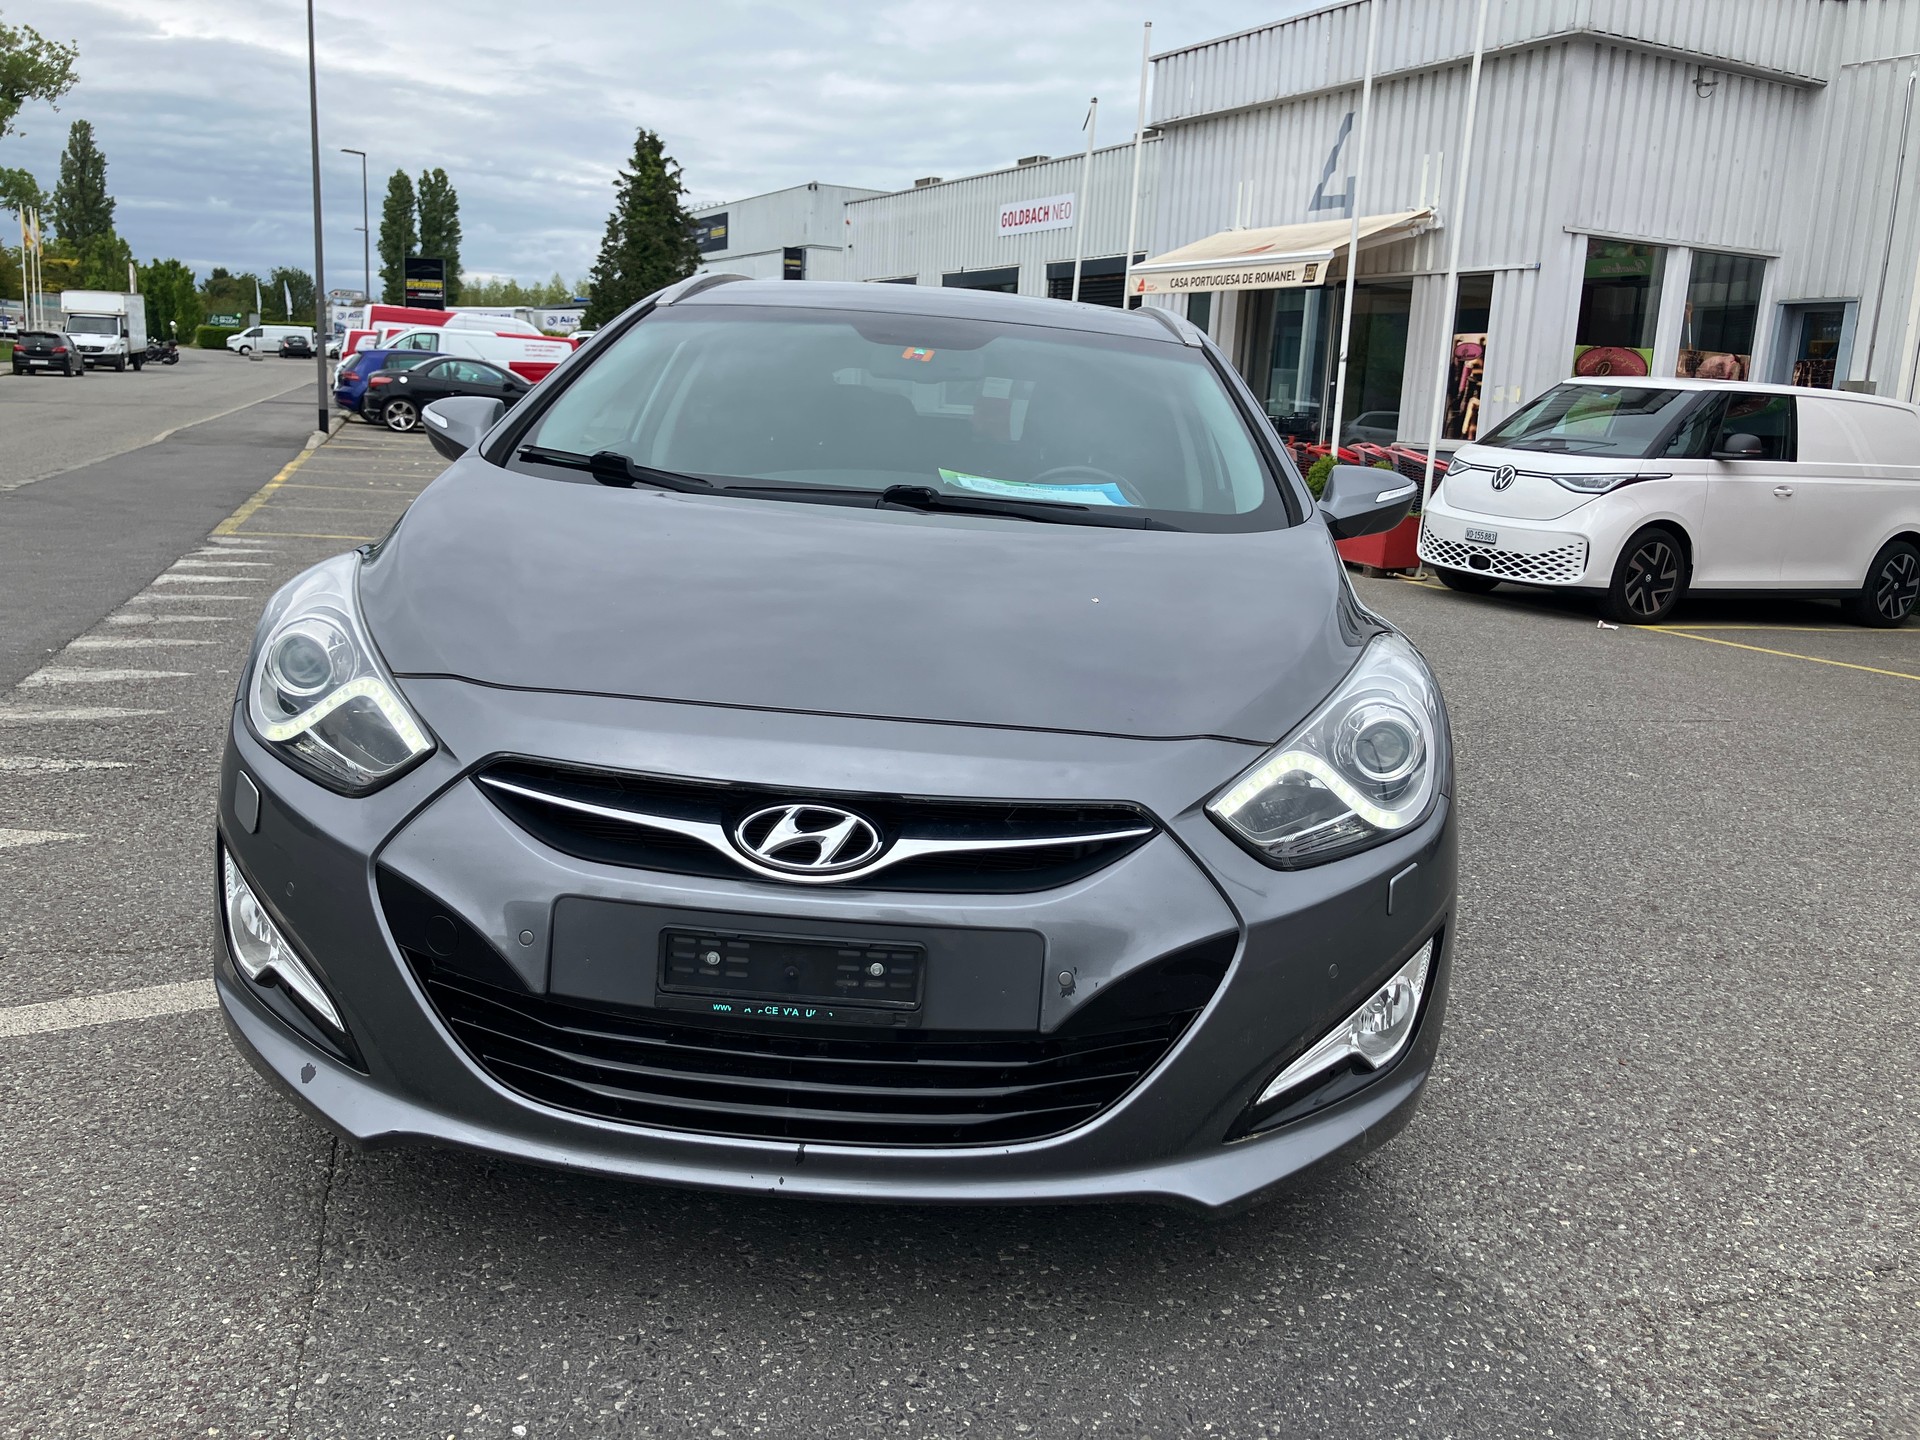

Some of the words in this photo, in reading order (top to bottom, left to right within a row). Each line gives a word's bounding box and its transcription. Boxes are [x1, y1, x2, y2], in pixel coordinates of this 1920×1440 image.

[1001, 205, 1050, 228] GOLDBACH
[1052, 202, 1072, 220] NEO
[1170, 277, 1189, 288] CASA
[1190, 274, 1240, 287] PORTUGUESA
[1242, 273, 1254, 284] DE
[1255, 270, 1296, 283] ROMANEL
